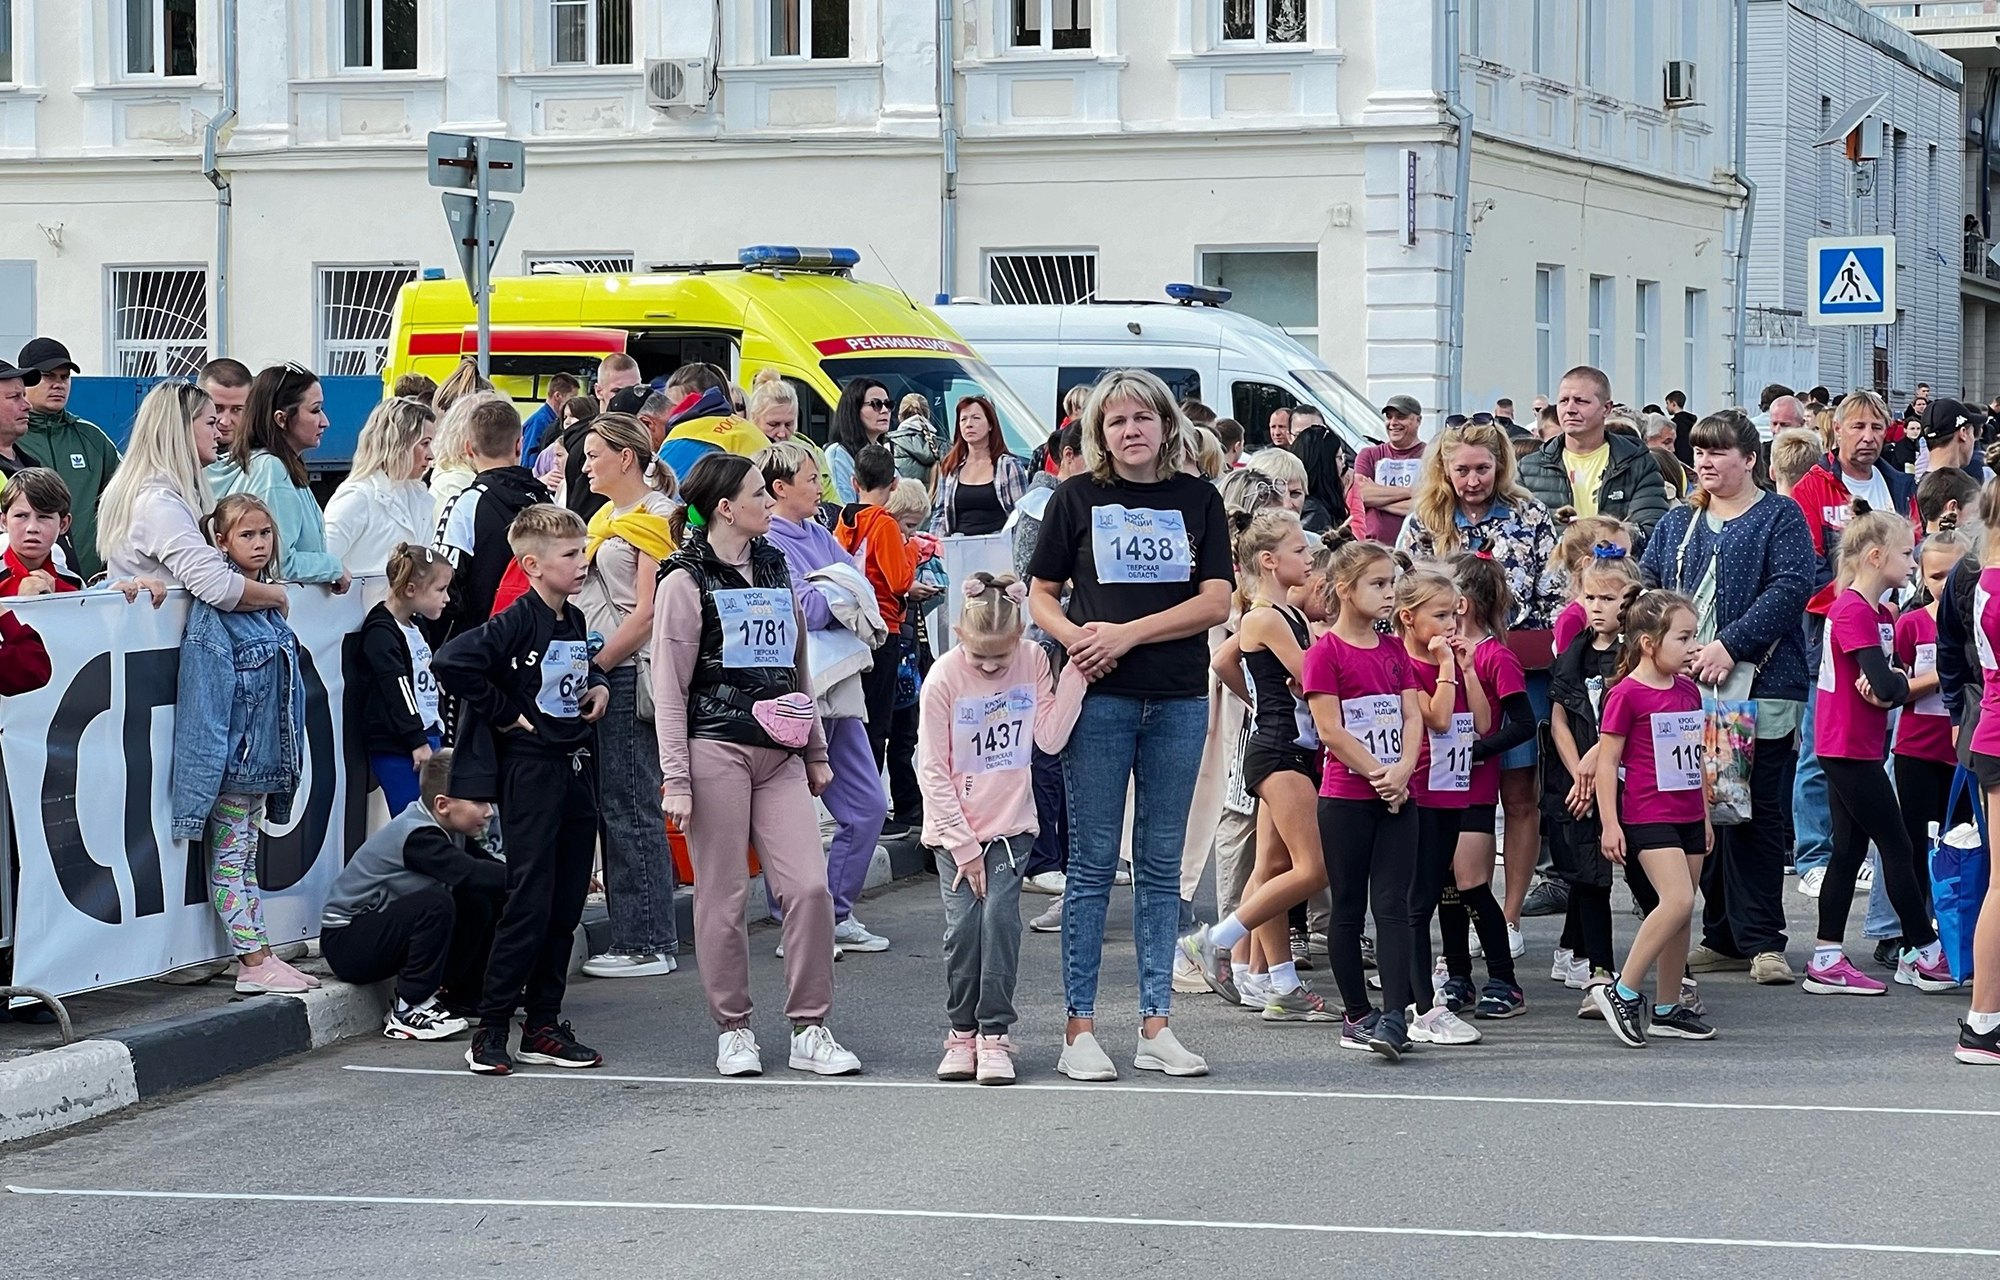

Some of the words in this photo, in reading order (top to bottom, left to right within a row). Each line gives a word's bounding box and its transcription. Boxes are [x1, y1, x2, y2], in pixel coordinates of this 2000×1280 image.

[846, 337, 952, 351] РЕАНИМАЦИЯ
[1110, 535, 1174, 561] 1438
[1128, 571, 1158, 579] ОБЛАСТЬ
[739, 619, 786, 646] 1781
[971, 720, 1023, 756] 1437
[984, 751, 1013, 763] ТВЕРСКАЯ
[985, 759, 1013, 770] ОБЛАСТЬ
